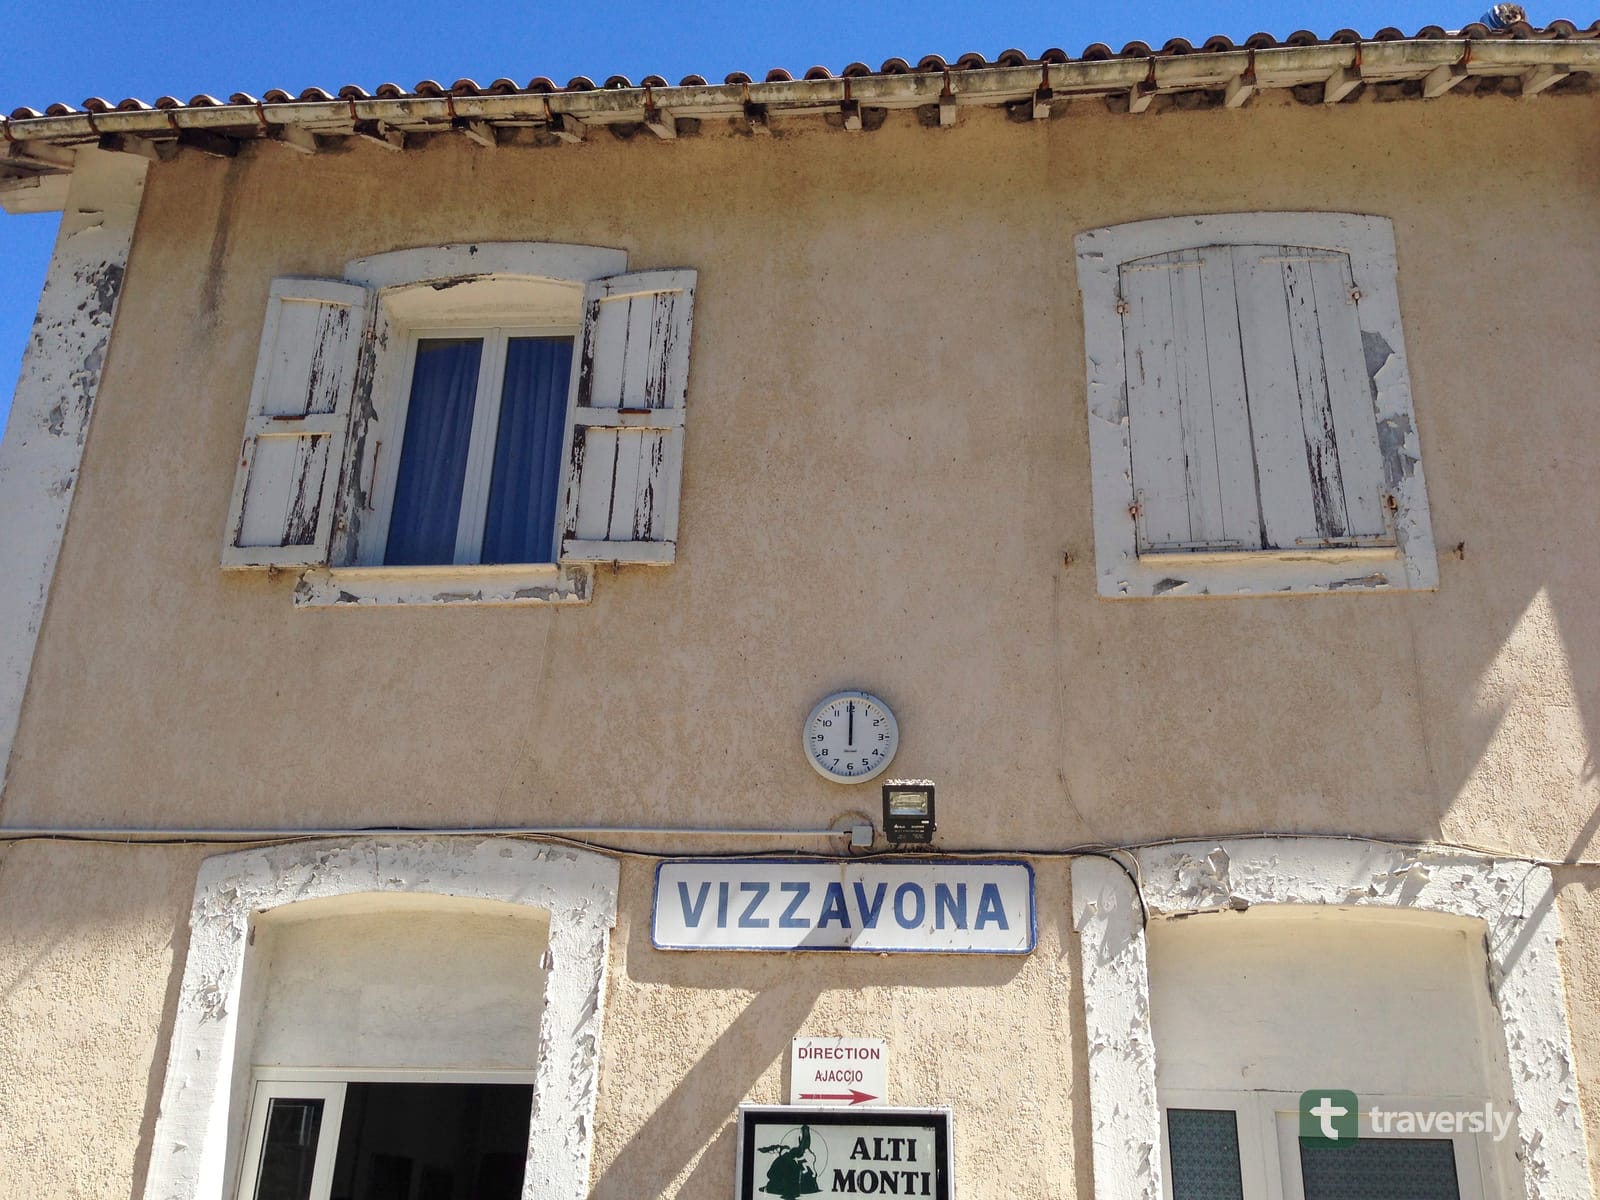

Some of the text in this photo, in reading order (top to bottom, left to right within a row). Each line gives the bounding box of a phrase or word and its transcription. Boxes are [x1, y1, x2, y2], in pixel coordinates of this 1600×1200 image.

[846, 705, 855, 713] 12
[677, 881, 1010, 930] VIZZAVONA
[798, 1047, 880, 1060] DIRECTION
[814, 1070, 863, 1082] AJACCIO
[849, 1136, 917, 1162] ALTI
[831, 1169, 931, 1196] MONTI
